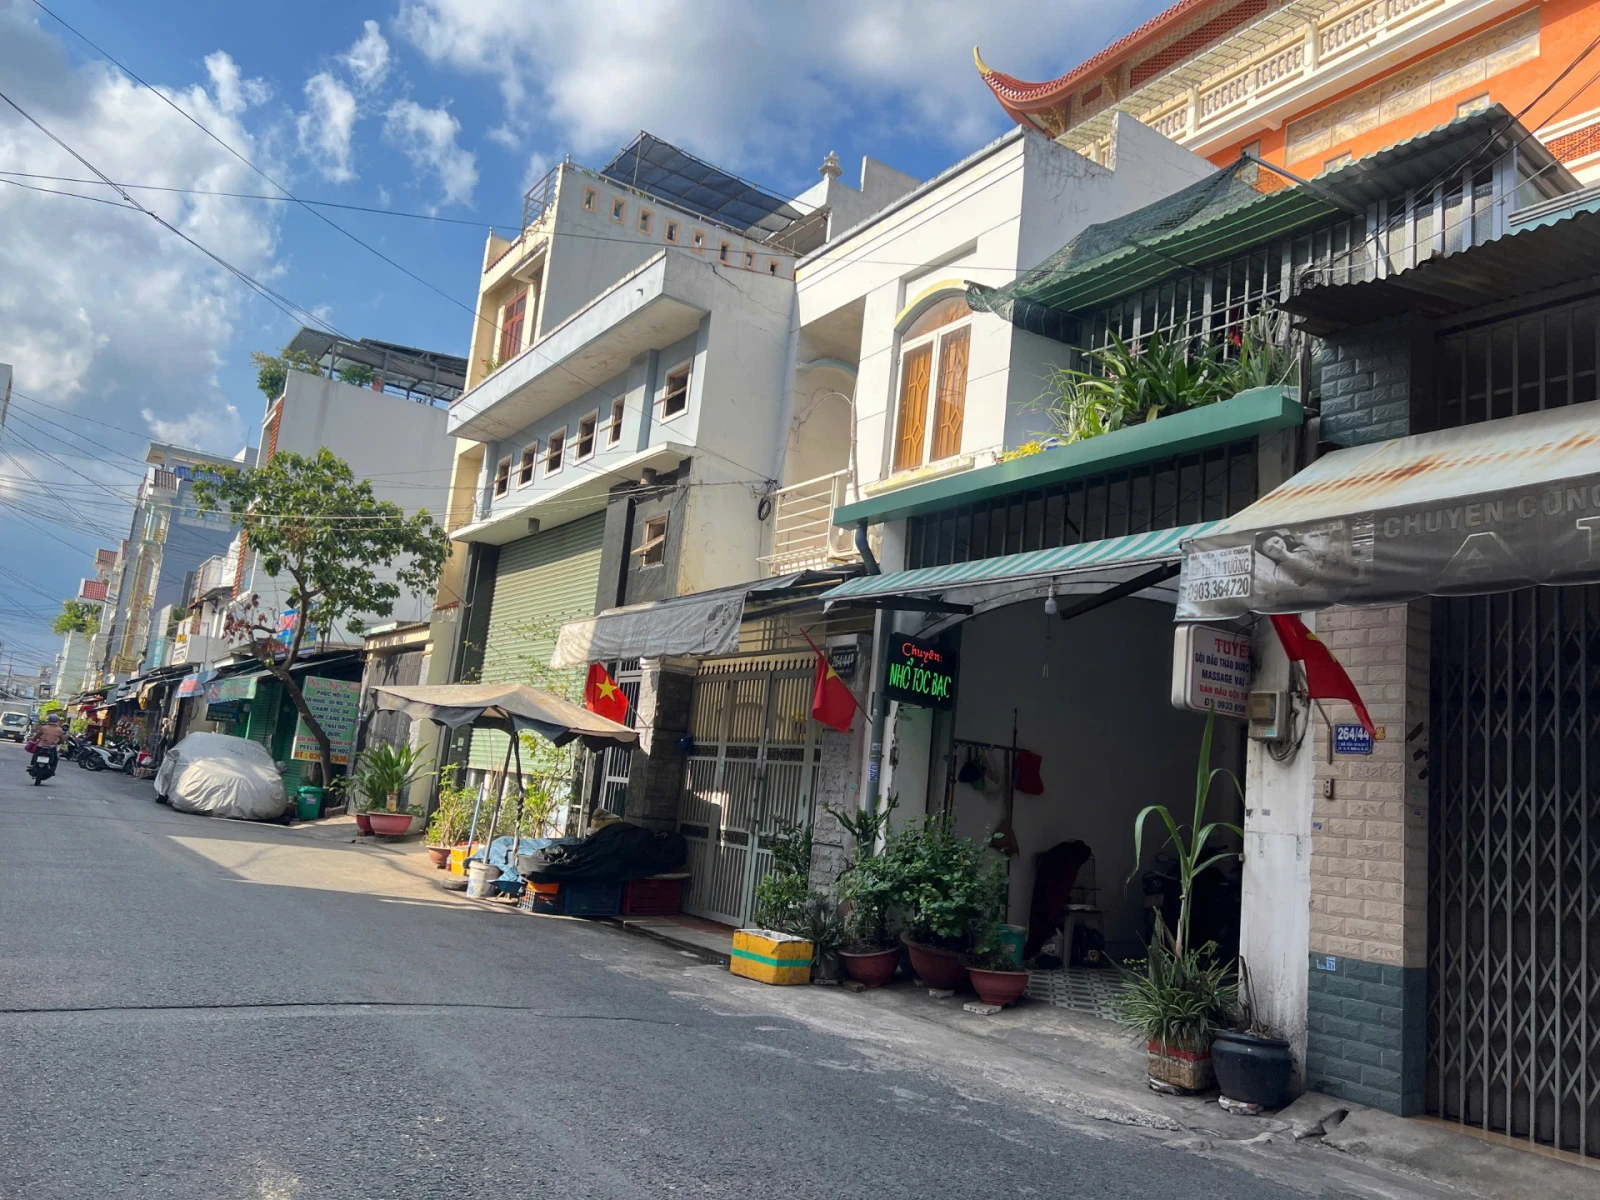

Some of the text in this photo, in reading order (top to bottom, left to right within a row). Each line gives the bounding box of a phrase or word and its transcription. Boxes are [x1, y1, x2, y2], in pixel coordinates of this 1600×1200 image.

[1383, 499, 1504, 539] CHUYÊN
[912, 663, 931, 695] TÓC
[1201, 669, 1233, 685] MASSAGE
